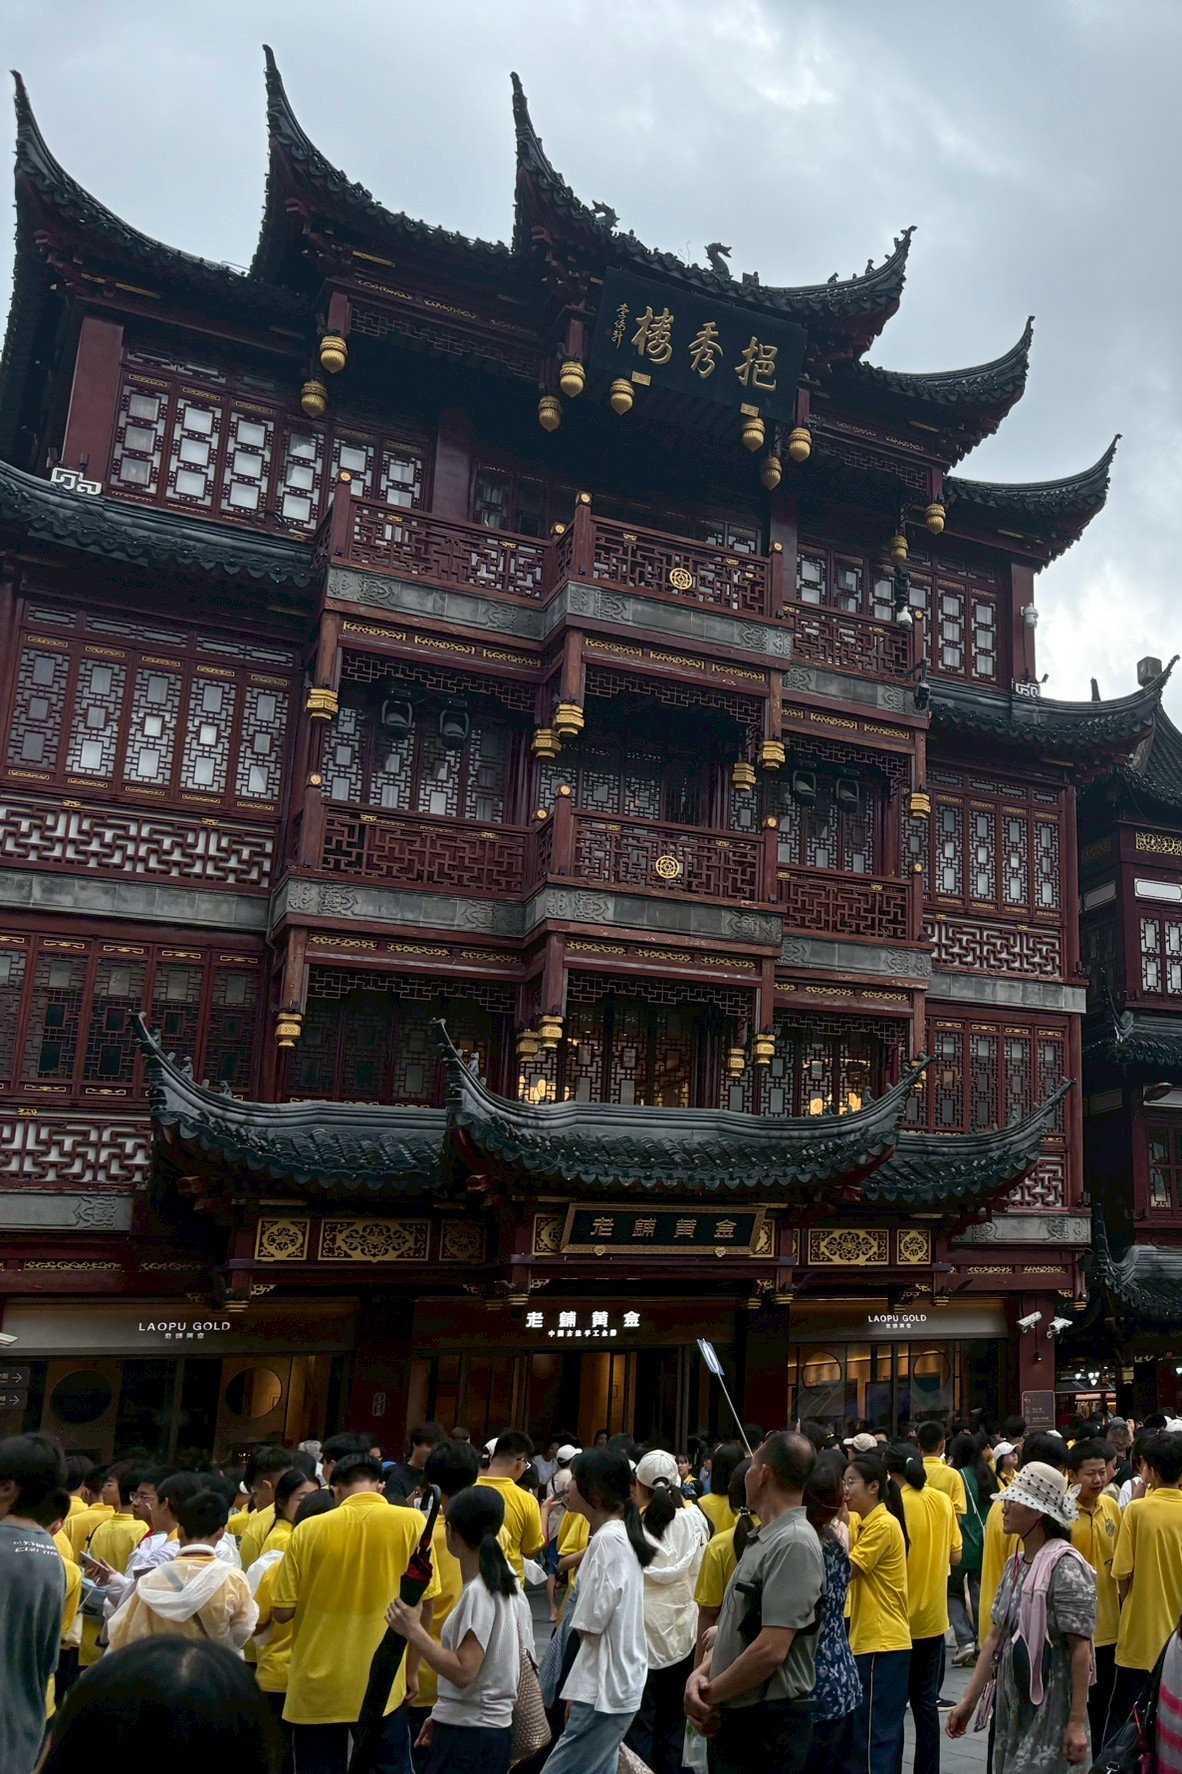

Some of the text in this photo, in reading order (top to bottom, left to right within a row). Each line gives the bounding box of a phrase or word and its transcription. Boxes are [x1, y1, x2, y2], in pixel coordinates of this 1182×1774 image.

[867, 1314, 927, 1323] LAOPU GOLD
[138, 1321, 231, 1331] LAOPU GOLD
